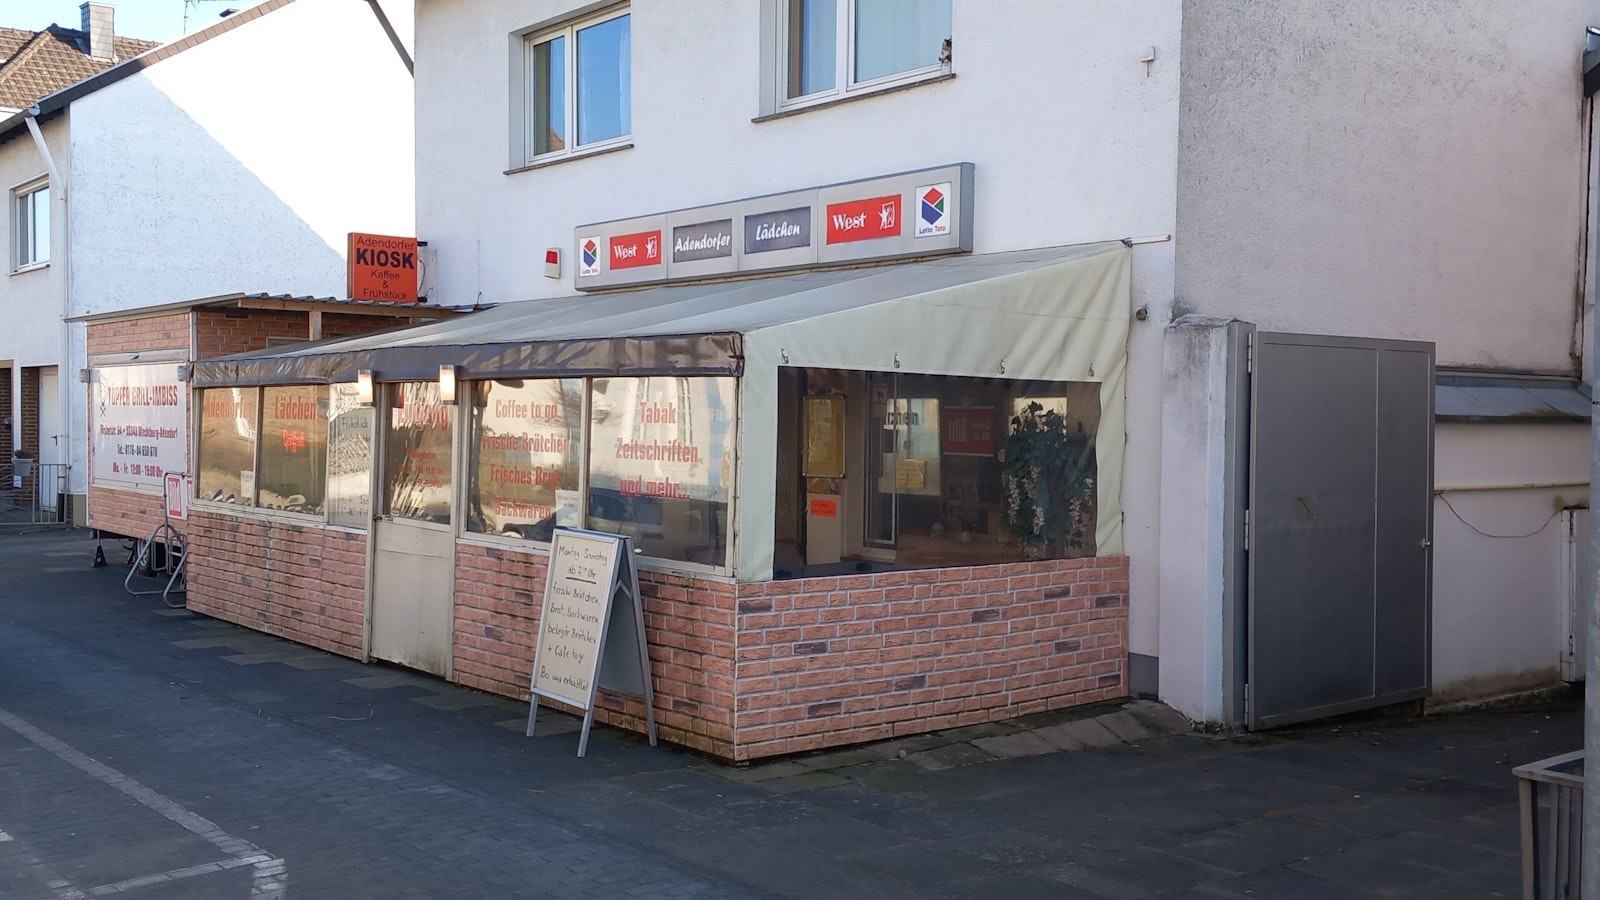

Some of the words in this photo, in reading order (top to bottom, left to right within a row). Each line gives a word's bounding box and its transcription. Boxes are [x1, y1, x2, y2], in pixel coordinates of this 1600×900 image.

[832, 213, 867, 232] West
[919, 227, 933, 235] Lotto
[357, 236, 415, 250] Adendorfer
[674, 233, 731, 253] Adendorfer
[755, 221, 801, 241] Lädchen
[356, 247, 415, 270] KIOSK
[613, 244, 638, 260] West
[371, 270, 400, 280] Kaffee
[363, 288, 408, 300] Frühstück
[274, 395, 317, 420] Lädchen
[495, 399, 527, 419] Coffee
[530, 401, 543, 419] to
[544, 403, 558, 422] go
[640, 401, 676, 424] Tabak
[482, 431, 518, 451] Frische
[521, 431, 570, 456] Brötchen
[490, 463, 532, 486] Frisches
[535, 466, 560, 488] Brot
[619, 475, 642, 497] und
[645, 477, 691, 500] mehr...
[494, 495, 553, 520] Backwaren
[568, 564, 577, 575] ab
